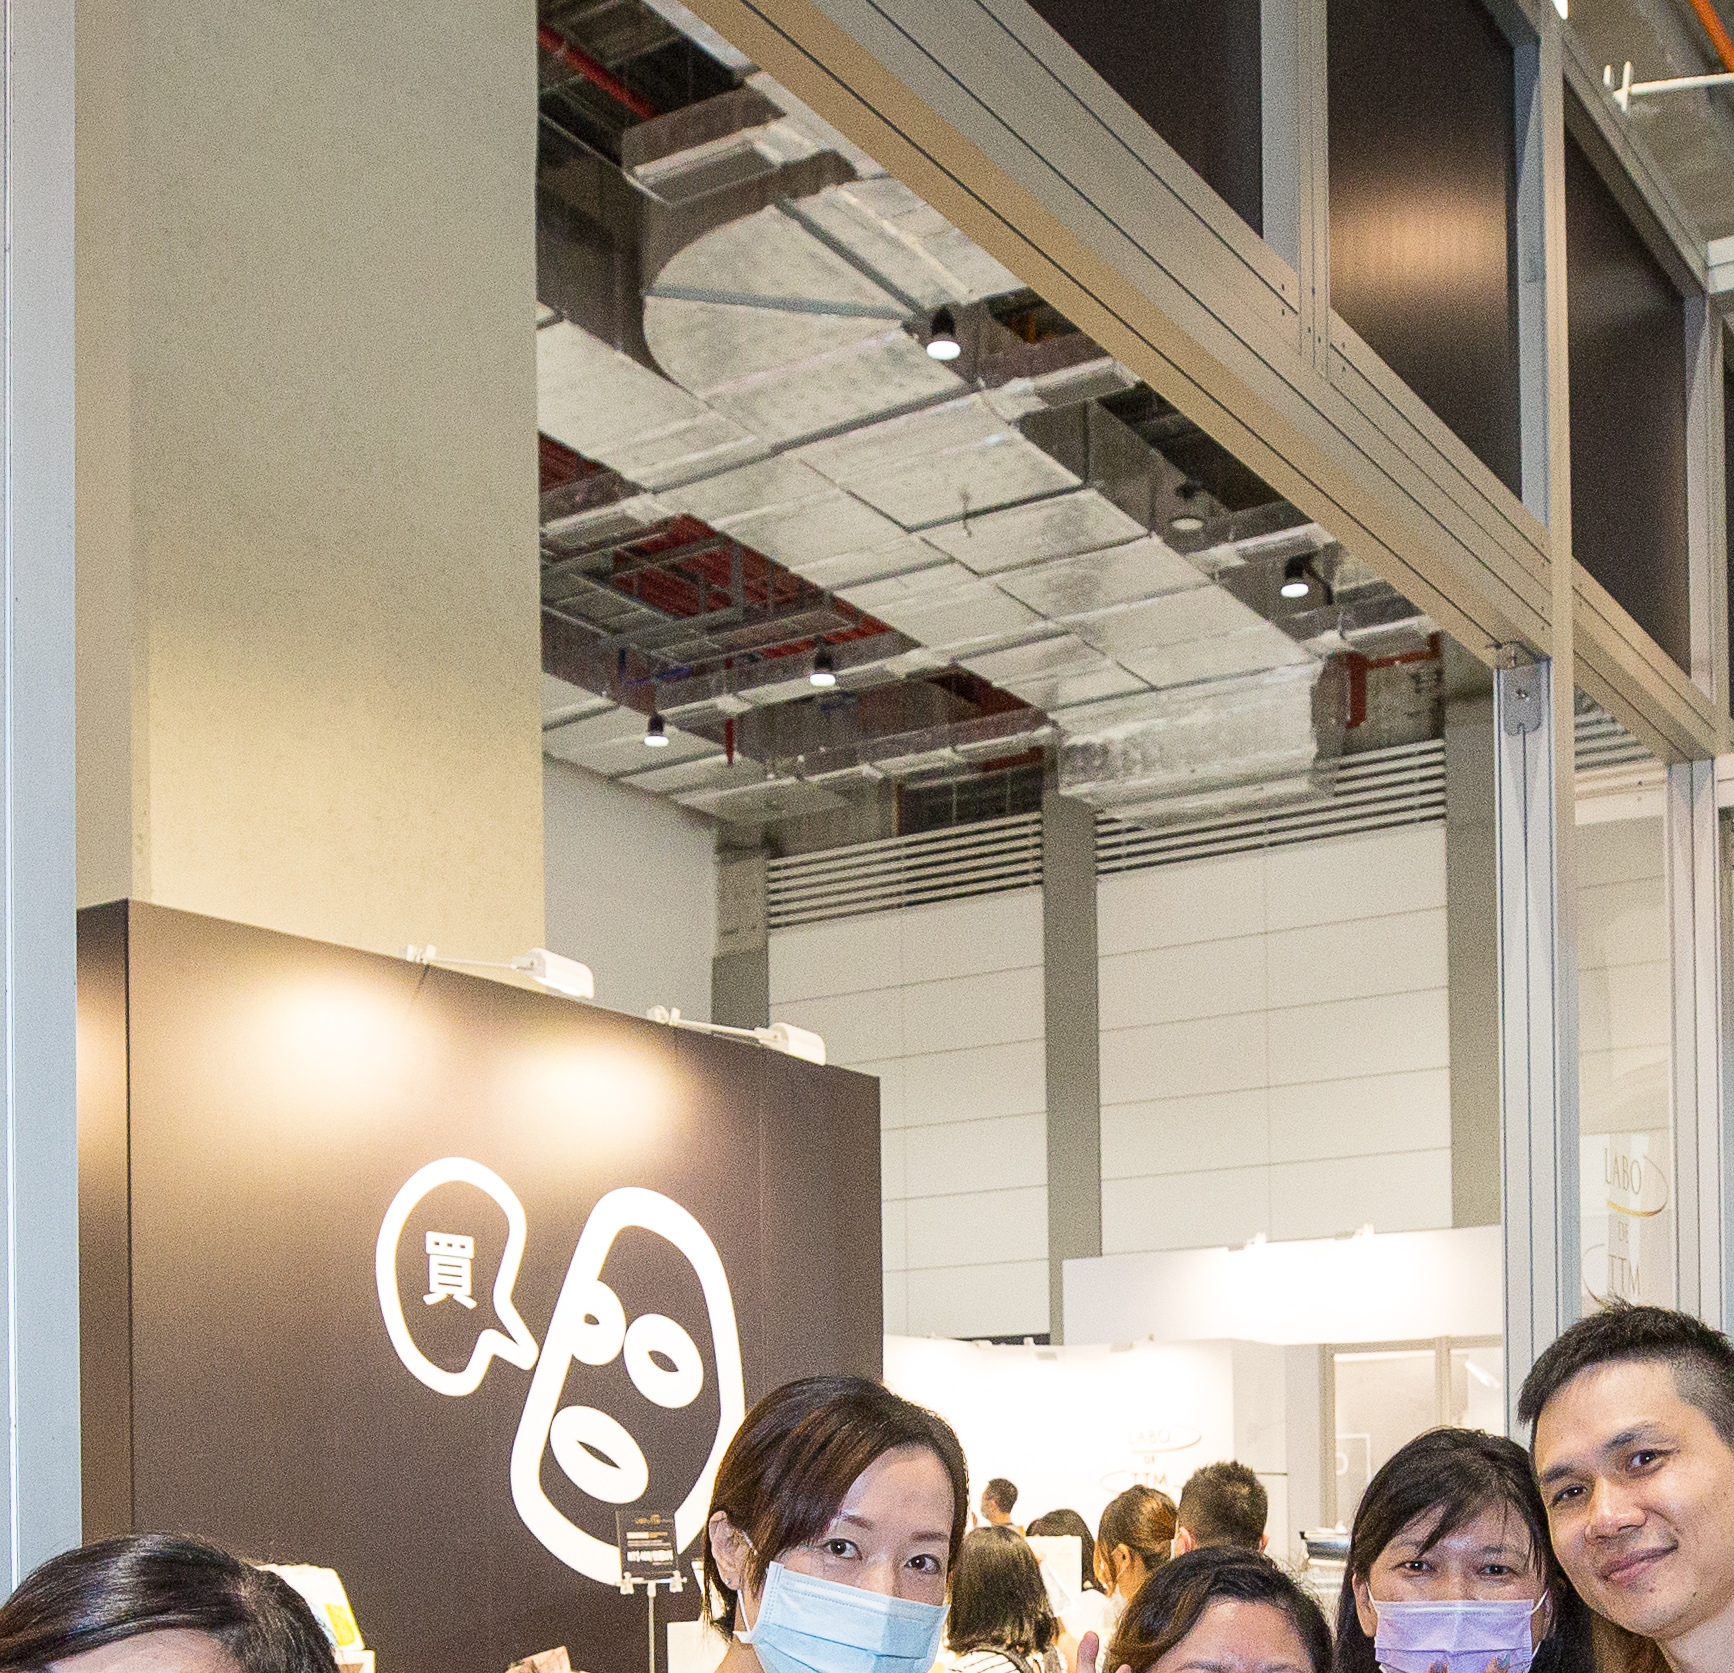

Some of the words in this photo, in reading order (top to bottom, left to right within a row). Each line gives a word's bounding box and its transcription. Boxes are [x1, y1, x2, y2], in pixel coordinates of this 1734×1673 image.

[1604, 1147, 1642, 1195] LABO
[422, 1230, 478, 1310] 買
[1608, 1254, 1641, 1296] TTM
[1129, 1429, 1171, 1445] LABO
[1130, 1472, 1168, 1488] TTM
